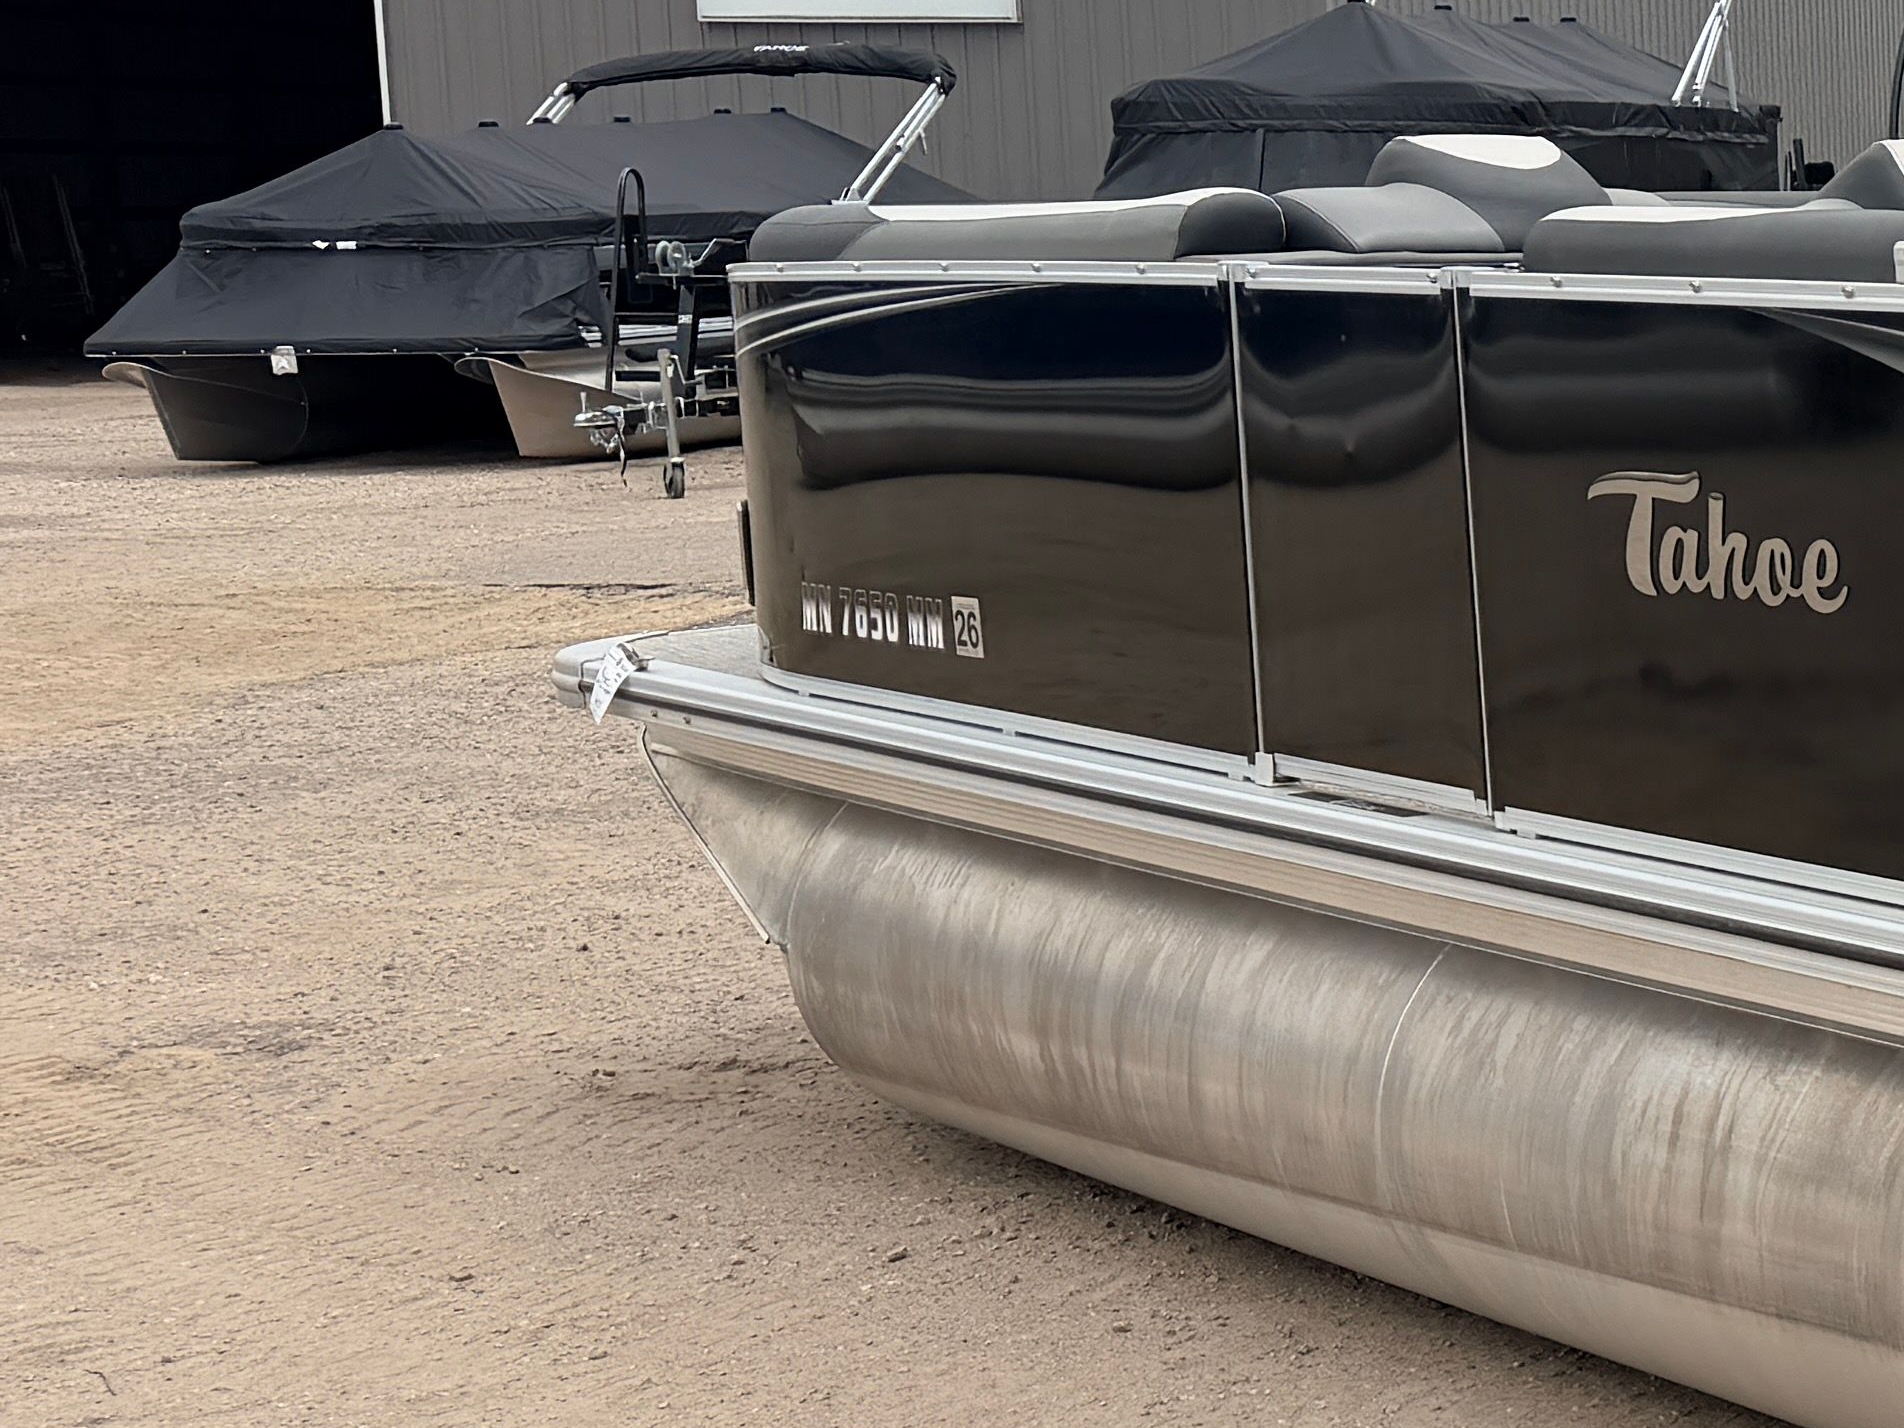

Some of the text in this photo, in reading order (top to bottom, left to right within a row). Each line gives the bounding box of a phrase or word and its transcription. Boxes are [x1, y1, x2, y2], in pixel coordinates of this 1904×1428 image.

[1587, 471, 1848, 614] Tahoe
[839, 586, 899, 642] 7650
[954, 609, 980, 649] 26
